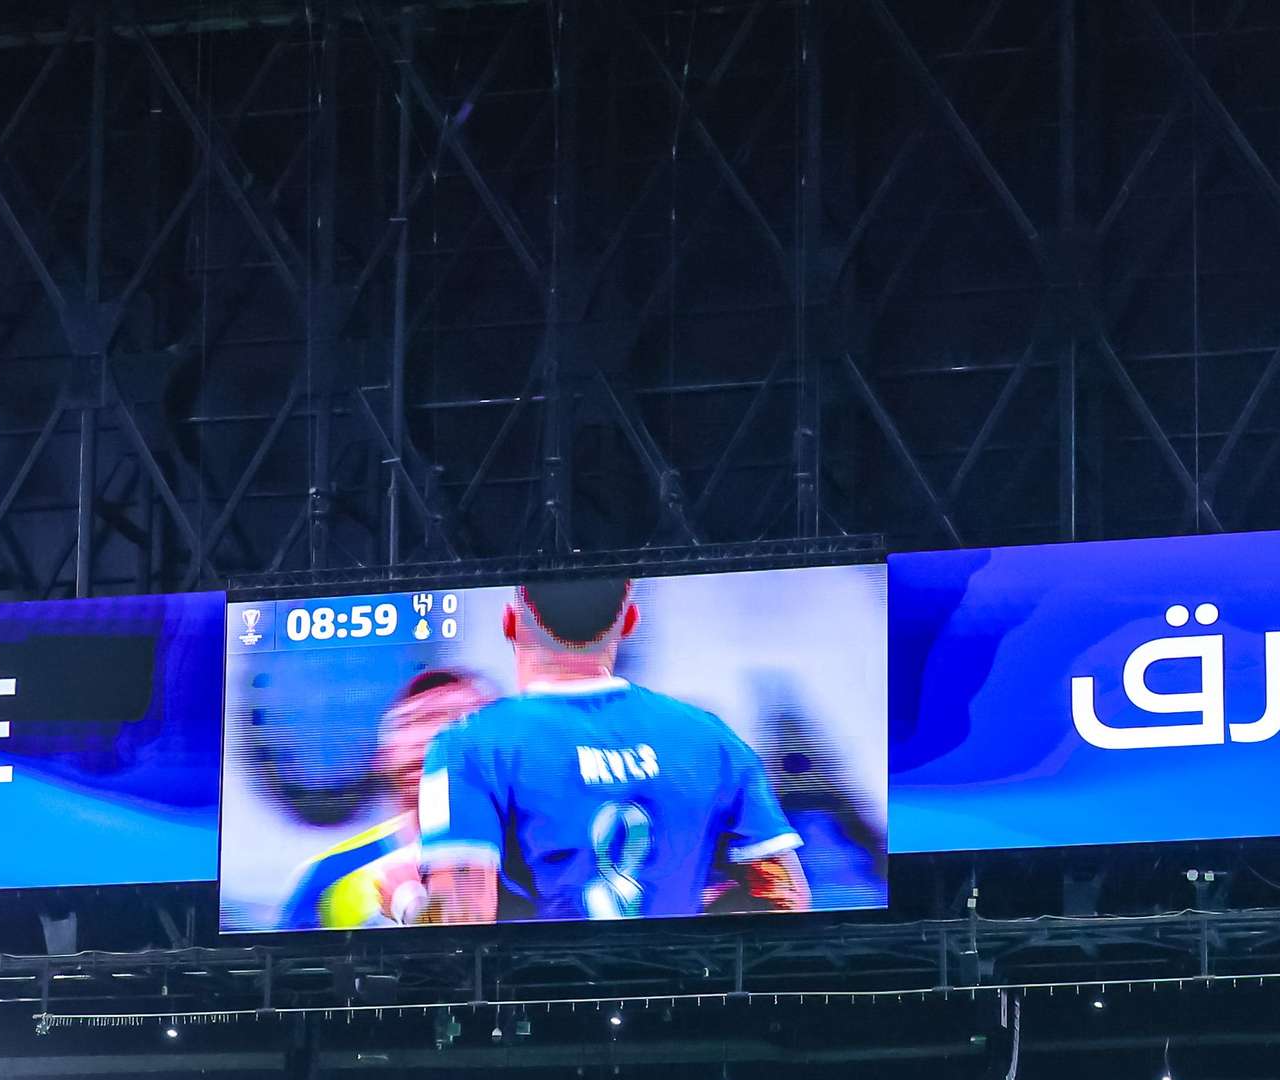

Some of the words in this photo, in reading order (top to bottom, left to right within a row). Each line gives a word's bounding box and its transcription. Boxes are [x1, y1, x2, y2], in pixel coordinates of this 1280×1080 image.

[442, 593, 458, 614] 0
[287, 603, 398, 642] 08:59
[441, 618, 458, 639] 0
